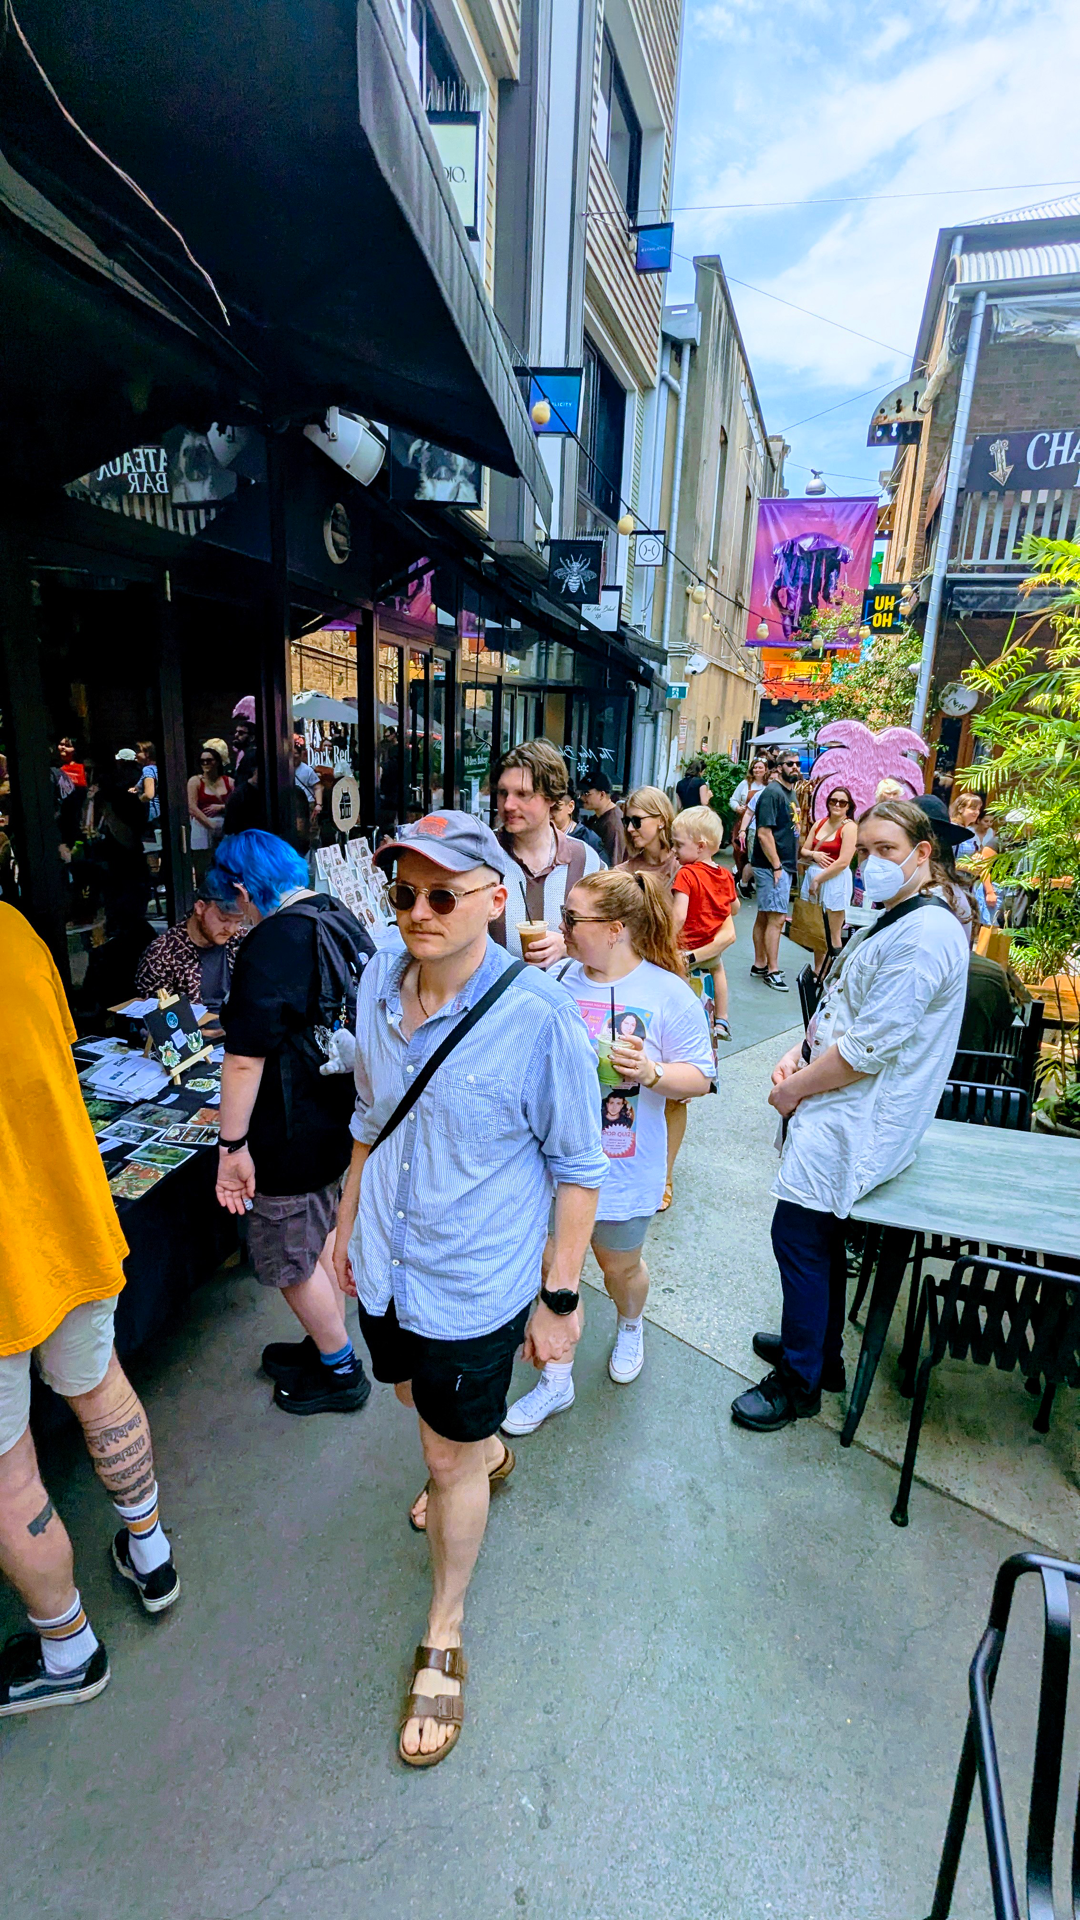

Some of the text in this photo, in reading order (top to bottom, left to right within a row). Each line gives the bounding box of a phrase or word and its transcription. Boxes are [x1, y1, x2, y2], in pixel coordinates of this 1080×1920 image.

[874, 595, 896, 611] UH
[872, 612, 893, 628] OH
[307, 745, 332, 767] Dark
